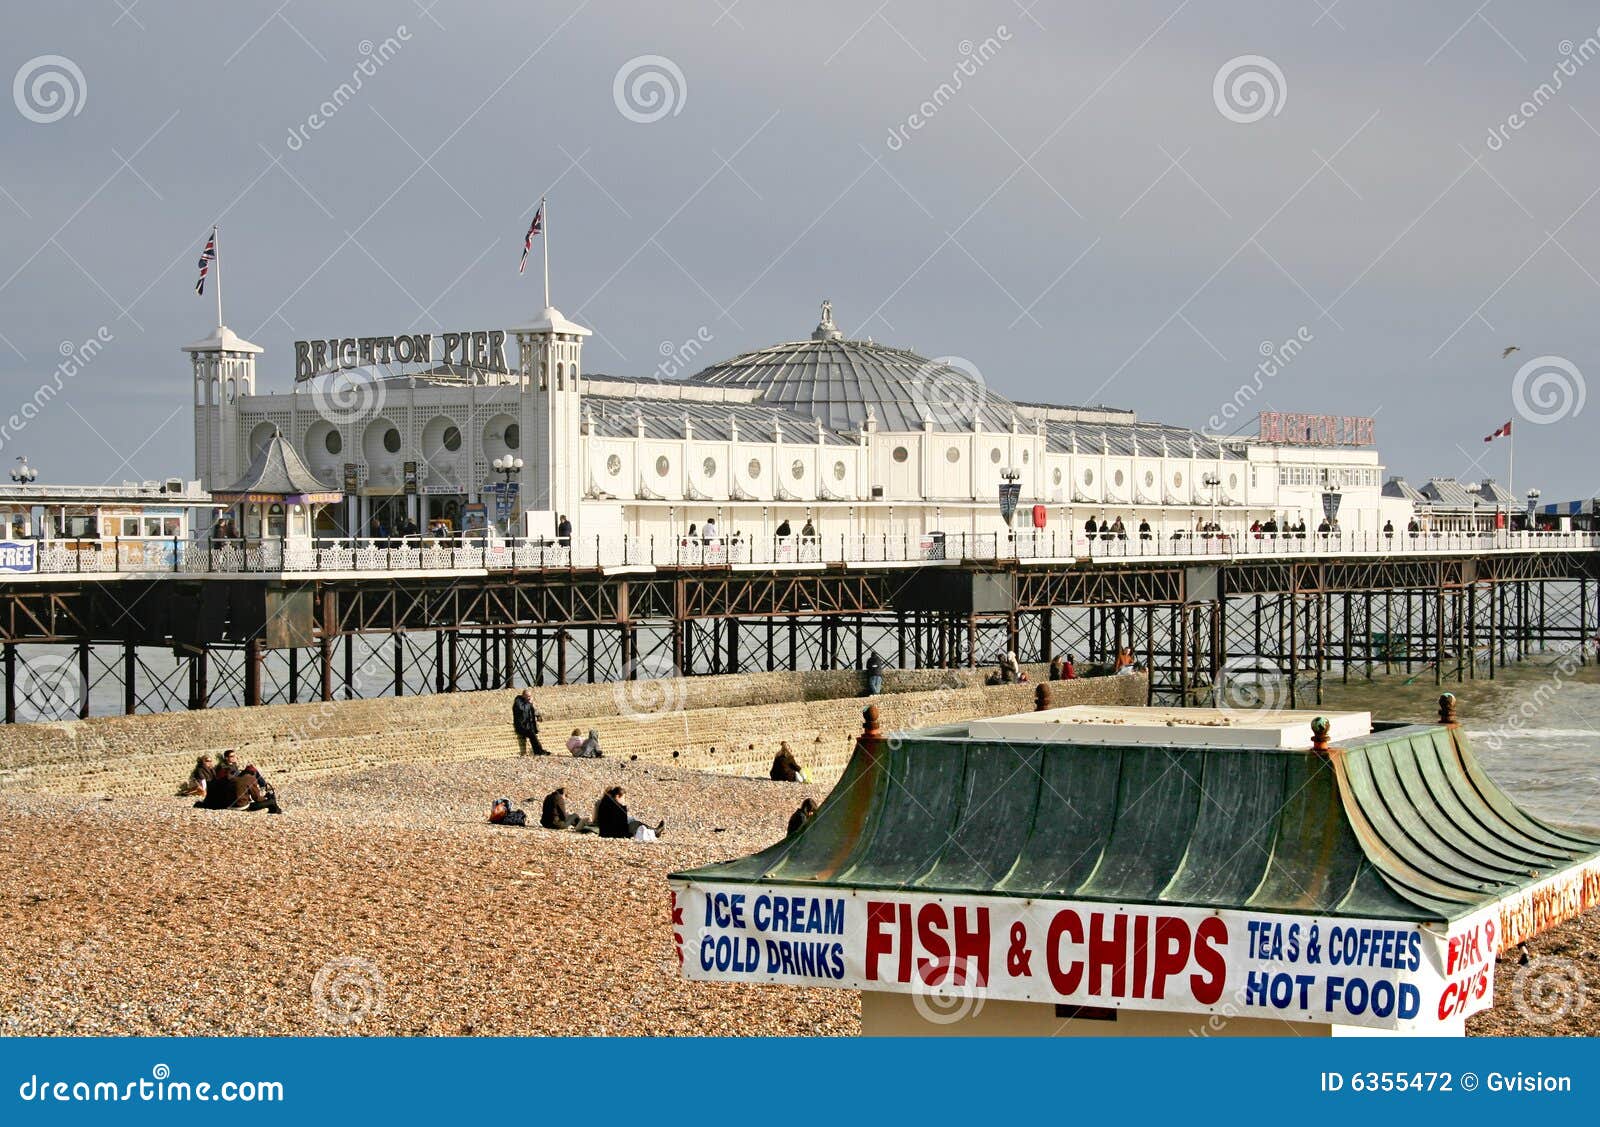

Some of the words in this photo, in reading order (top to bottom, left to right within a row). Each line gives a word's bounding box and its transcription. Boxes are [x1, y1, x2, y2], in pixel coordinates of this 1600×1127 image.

[294, 334, 432, 383] BRIGHTON
[442, 330, 510, 375] PIER
[1259, 411, 1337, 442] BRIGHTON
[1343, 416, 1376, 444] PIER
[704, 892, 746, 929] ICE
[753, 894, 845, 935] CREAM
[700, 934, 760, 973] COLD
[766, 939, 845, 980] DRINKS
[865, 901, 990, 987] FISH
[1007, 920, 1032, 977] &
[1046, 909, 1229, 1005] CHIPS
[1306, 924, 1321, 964] &
[1328, 926, 1421, 972] COFFEES
[1246, 970, 1316, 1009] HOT
[1325, 976, 1421, 1020] FOOD
